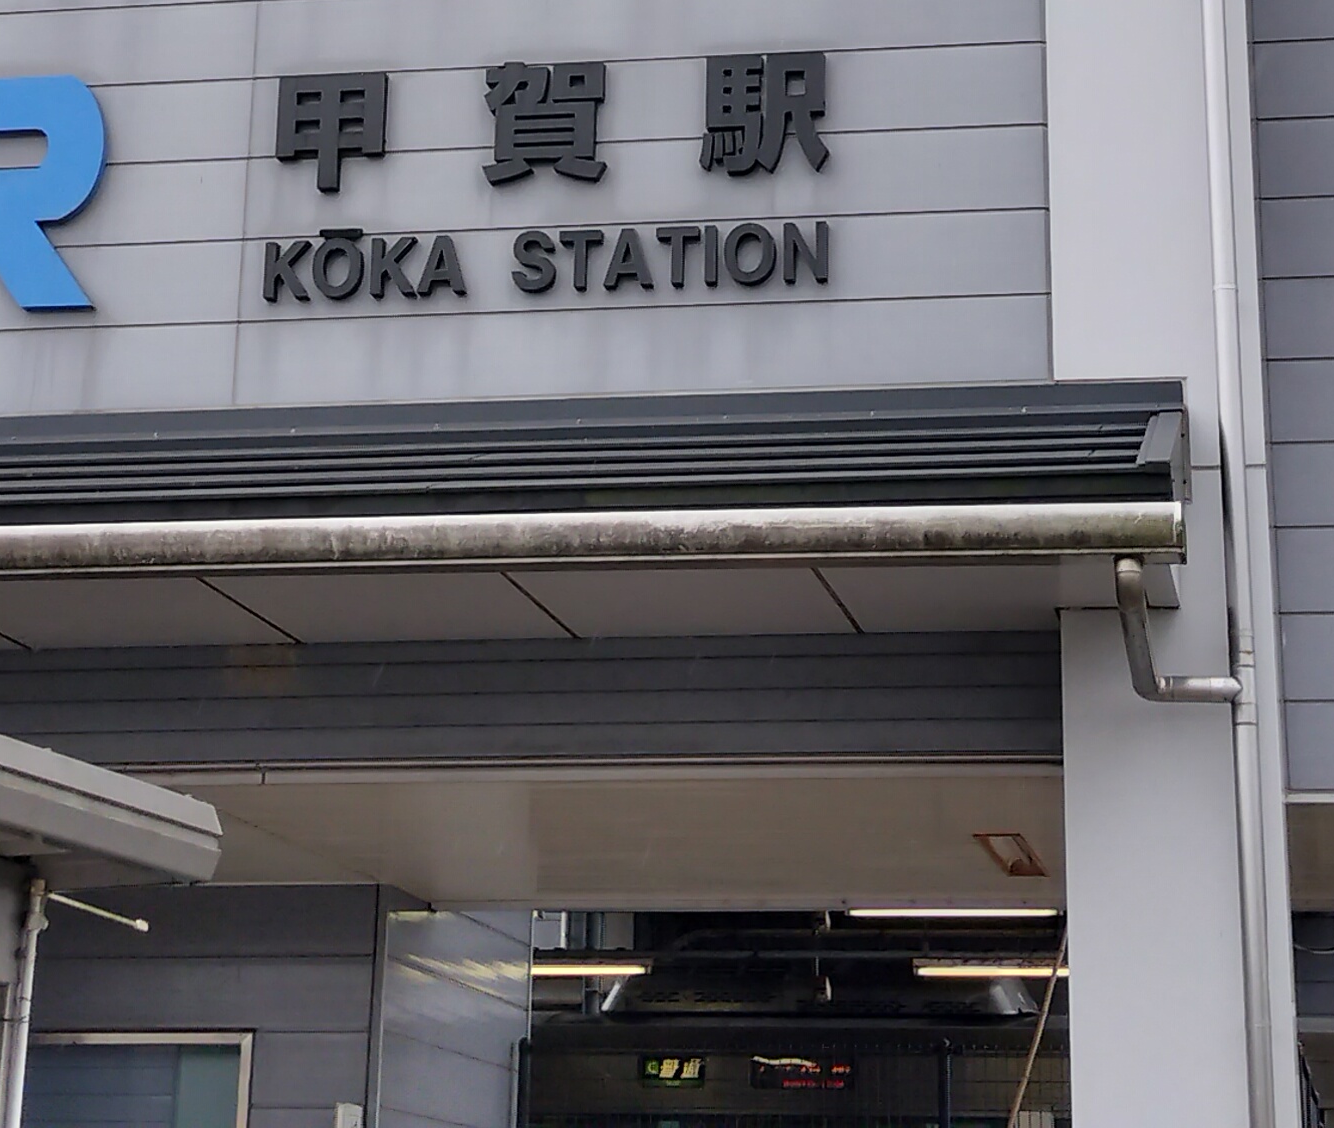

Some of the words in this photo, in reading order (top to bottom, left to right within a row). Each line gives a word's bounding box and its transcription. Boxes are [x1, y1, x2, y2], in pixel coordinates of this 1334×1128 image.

[275, 51, 830, 193] 甲賀駅
[262, 228, 468, 303] KŌKA
[510, 221, 829, 294] STATION
